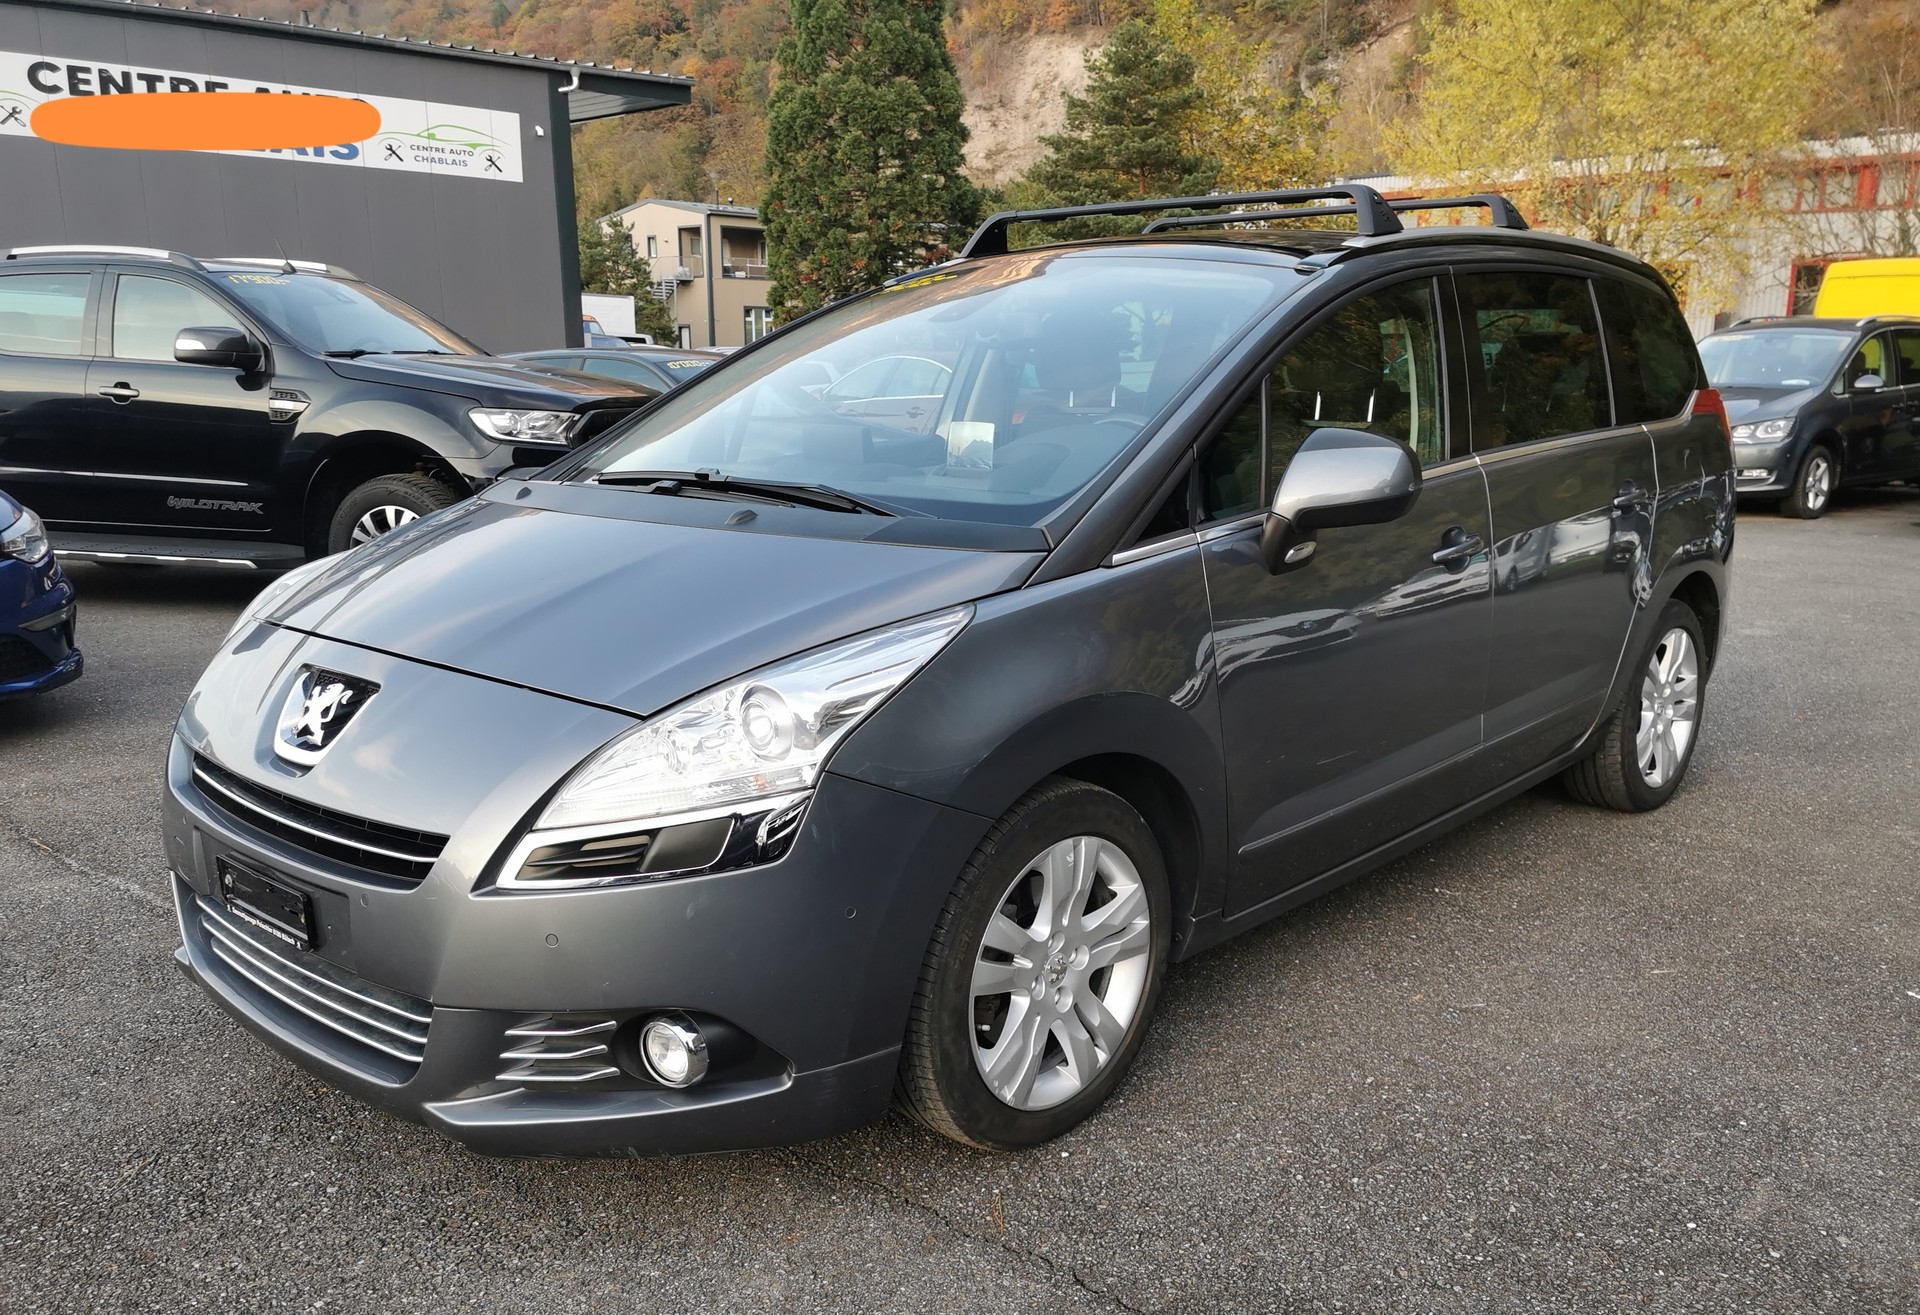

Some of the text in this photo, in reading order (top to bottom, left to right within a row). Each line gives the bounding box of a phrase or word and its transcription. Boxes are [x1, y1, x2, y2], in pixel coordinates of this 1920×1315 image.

[409, 143, 475, 158] CENTRE AUTO
[413, 154, 469, 168] CHABLAIS
[166, 495, 264, 515] WILDTRAK
